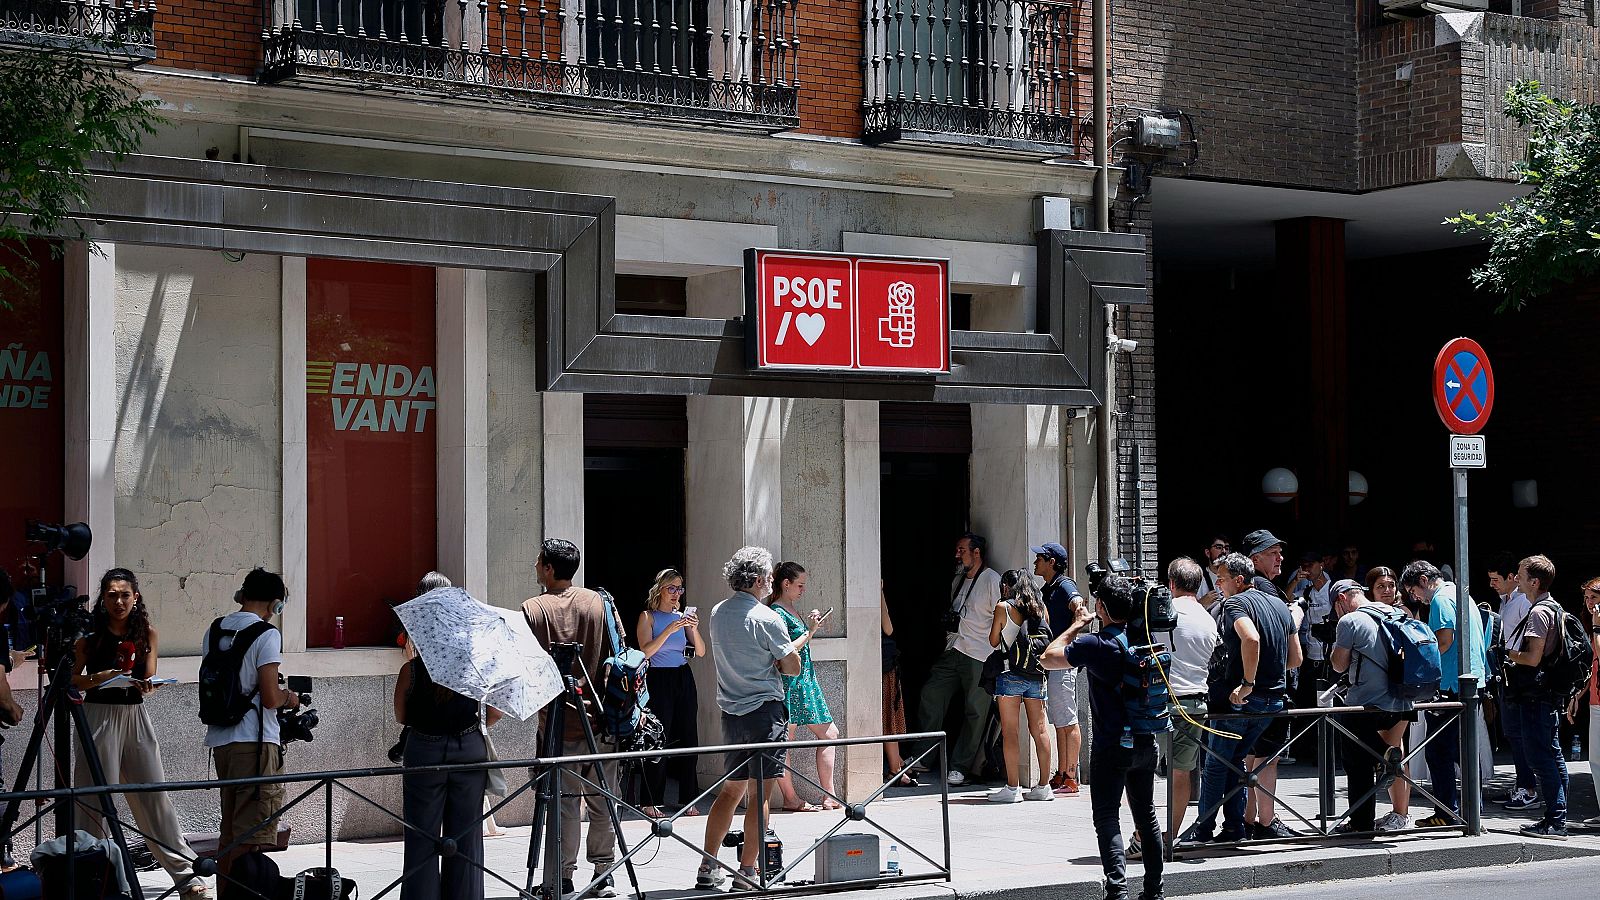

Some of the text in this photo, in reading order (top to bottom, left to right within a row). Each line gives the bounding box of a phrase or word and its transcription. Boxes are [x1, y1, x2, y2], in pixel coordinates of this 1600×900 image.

[773, 275, 843, 310] PSOE
[0, 342, 52, 381] ÑA
[332, 362, 436, 398] ENDA
[331, 397, 436, 433] VANT
[1453, 452, 1483, 461] SEGURIDAD
[1456, 442, 1479, 451] ZONA DE
